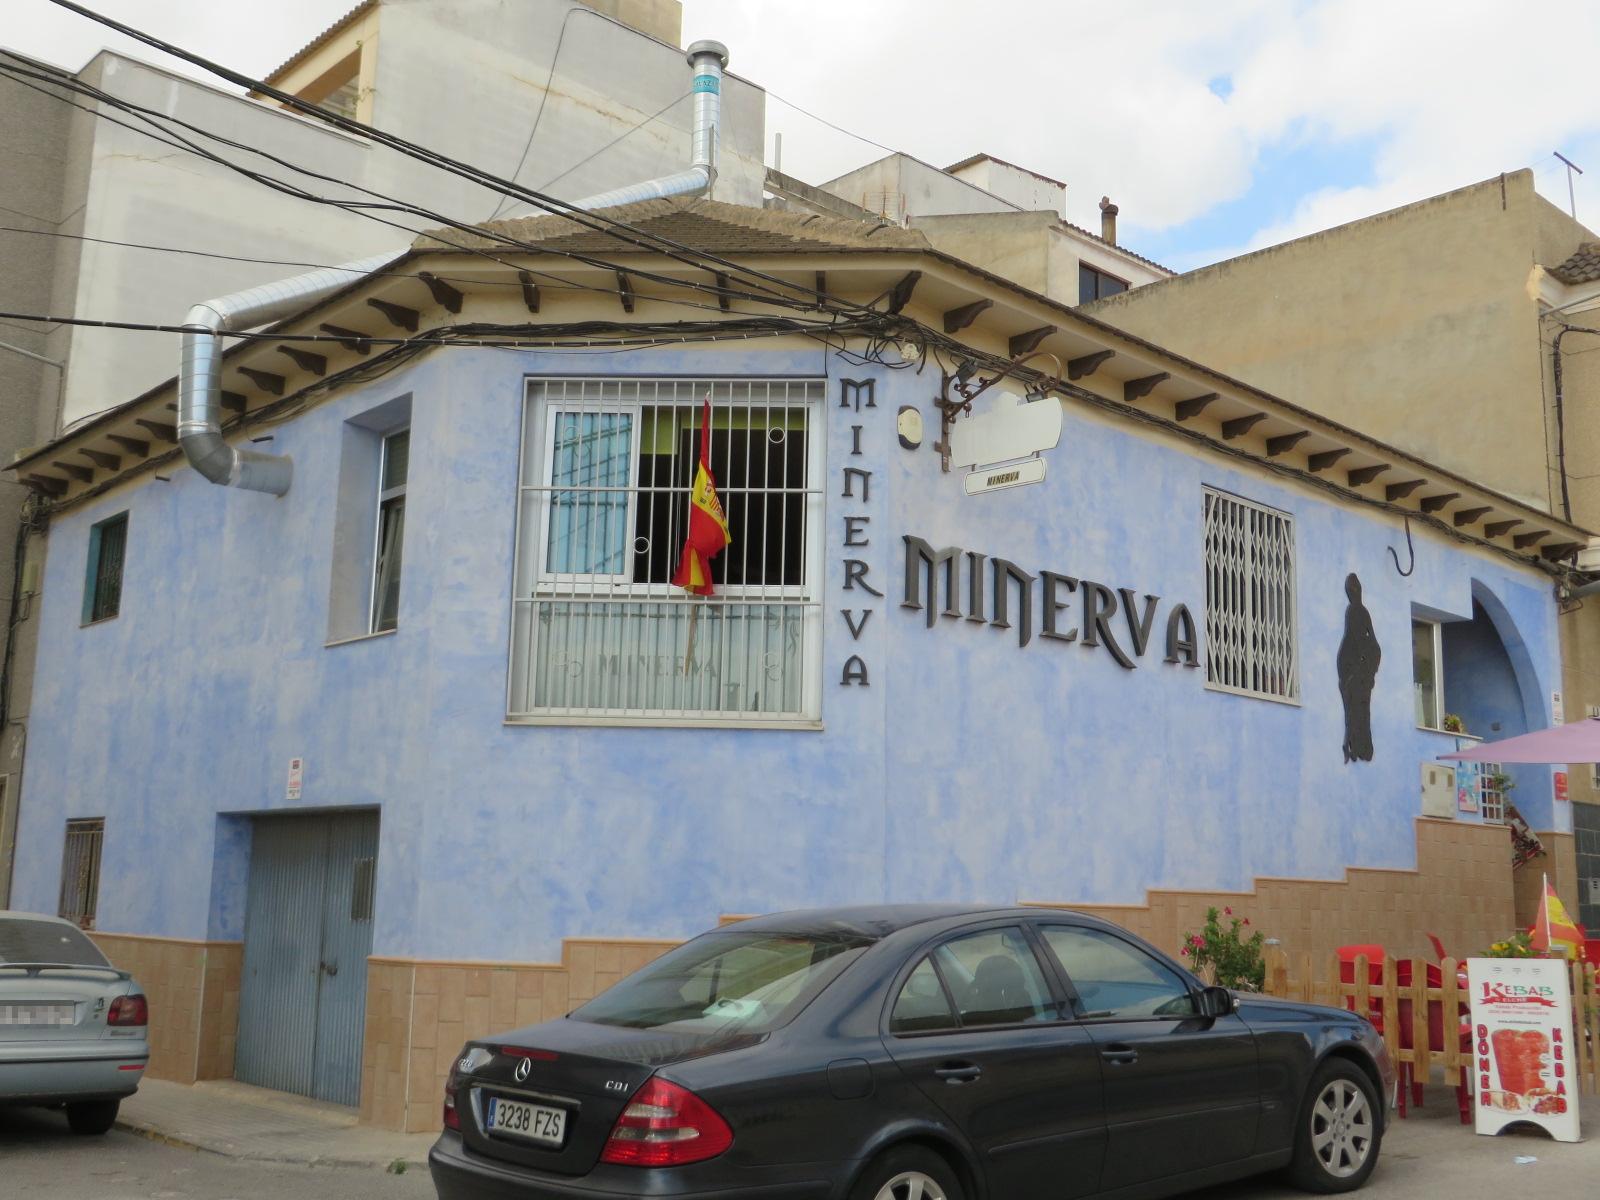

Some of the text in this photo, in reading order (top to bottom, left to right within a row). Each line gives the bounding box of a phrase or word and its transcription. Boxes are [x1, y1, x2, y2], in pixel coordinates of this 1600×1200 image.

[986, 471, 1021, 487] MINERVA
[840, 376, 884, 687] MINERVA
[900, 534, 1201, 670] MINERVA
[1482, 981, 1554, 998] KEBAB
[1552, 1027, 1568, 1114] KEBAB
[498, 1103, 561, 1137] 3238 FZS
